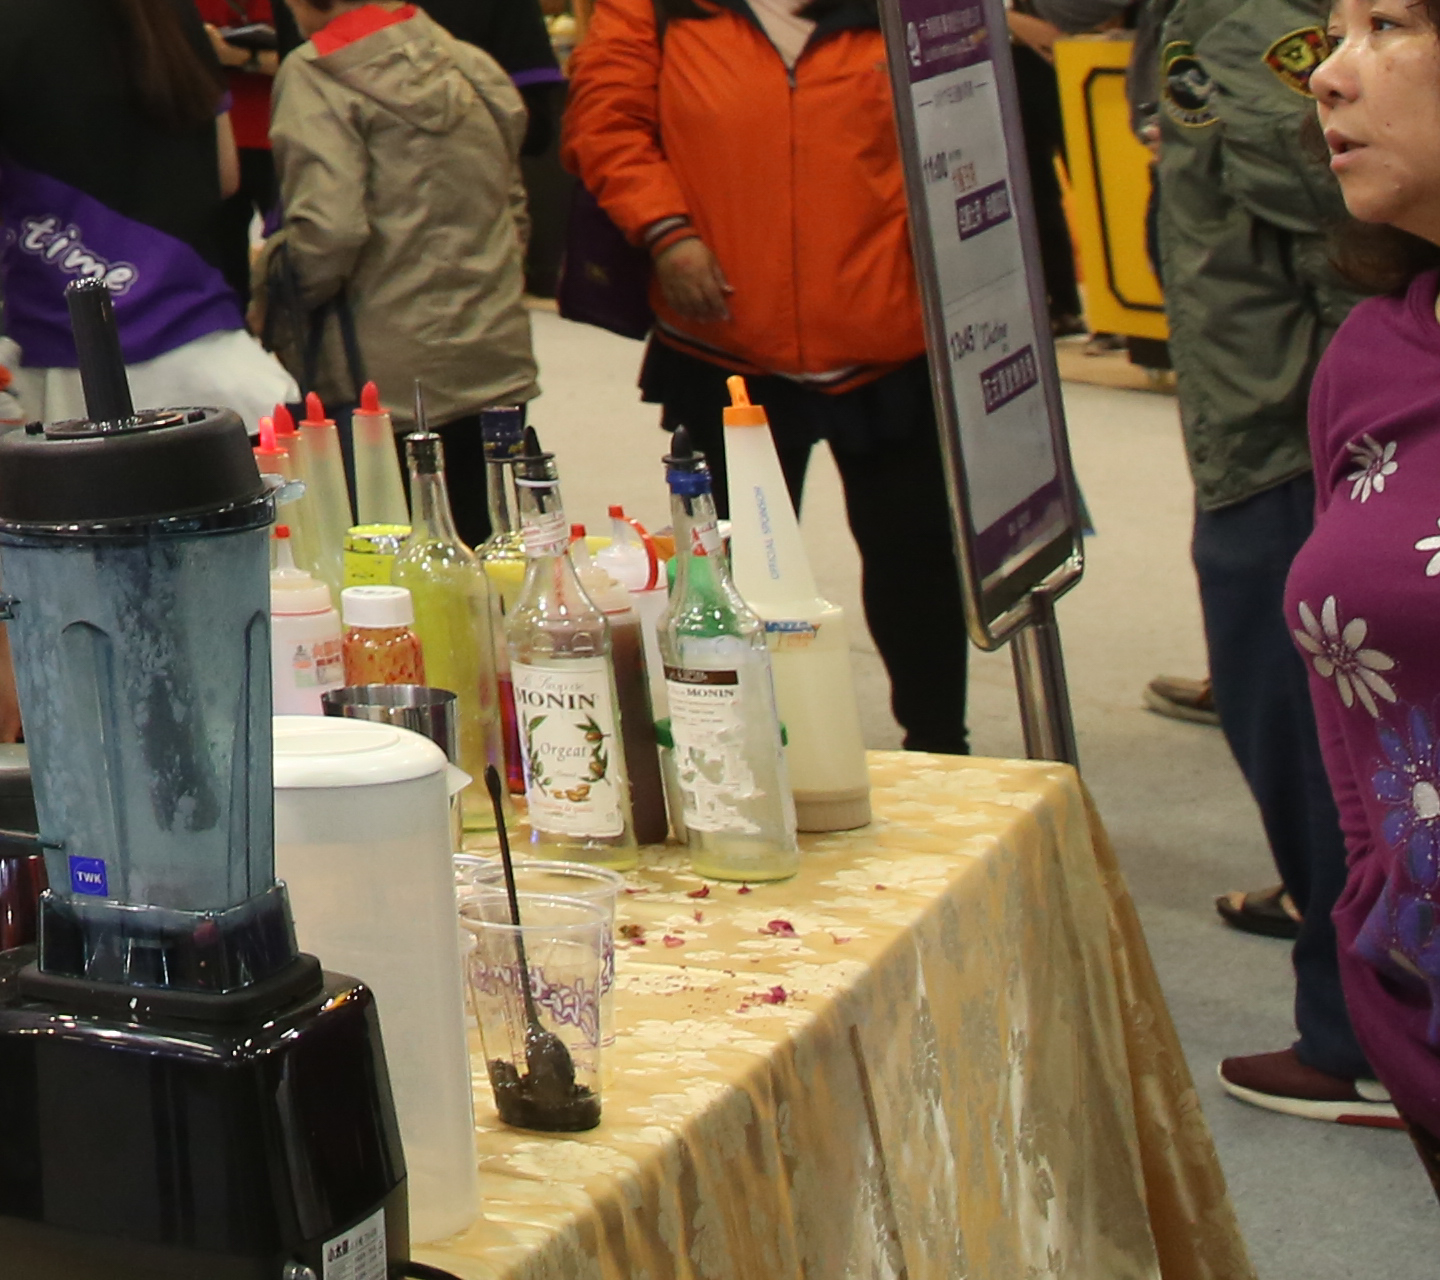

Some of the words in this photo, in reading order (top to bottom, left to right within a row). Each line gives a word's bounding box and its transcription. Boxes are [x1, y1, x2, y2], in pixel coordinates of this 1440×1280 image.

[515, 687, 596, 711] MONIN
[539, 741, 589, 763] Orgeat
[76, 870, 102, 885] TWK
